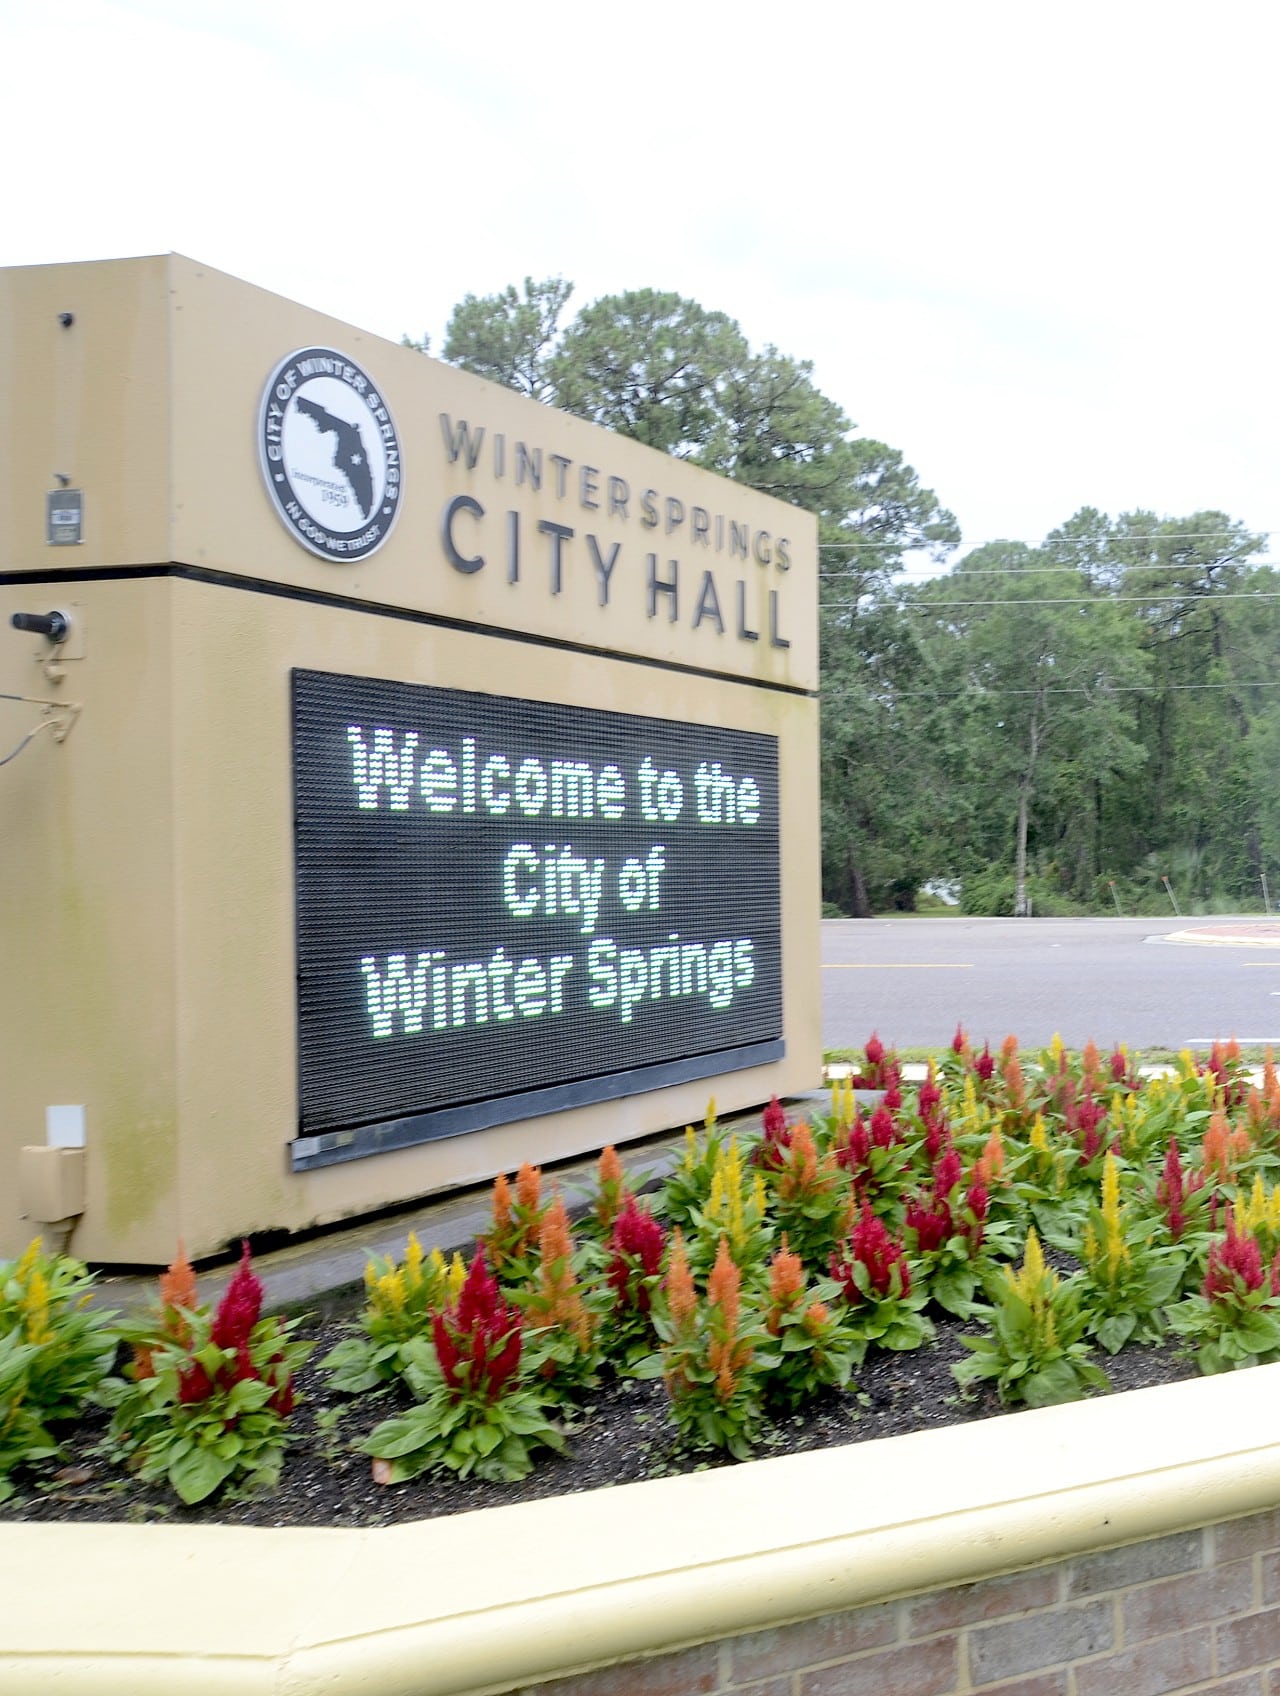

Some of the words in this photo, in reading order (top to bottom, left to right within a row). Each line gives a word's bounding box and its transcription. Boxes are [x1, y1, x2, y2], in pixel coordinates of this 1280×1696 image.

[267, 402, 284, 461] CITY
[276, 369, 297, 400] OF
[296, 357, 367, 393] WINTER
[366, 392, 400, 500] SPRINGS
[285, 501, 303, 520] IN
[441, 495, 622, 607] CITY
[646, 552, 792, 650] HALL
[346, 725, 626, 820] Welcome
[637, 756, 684, 821] to
[693, 761, 760, 825] the
[503, 843, 605, 933] City
[618, 845, 666, 911] of
[360, 946, 573, 1038] Winter
[587, 933, 755, 1023] Springs
